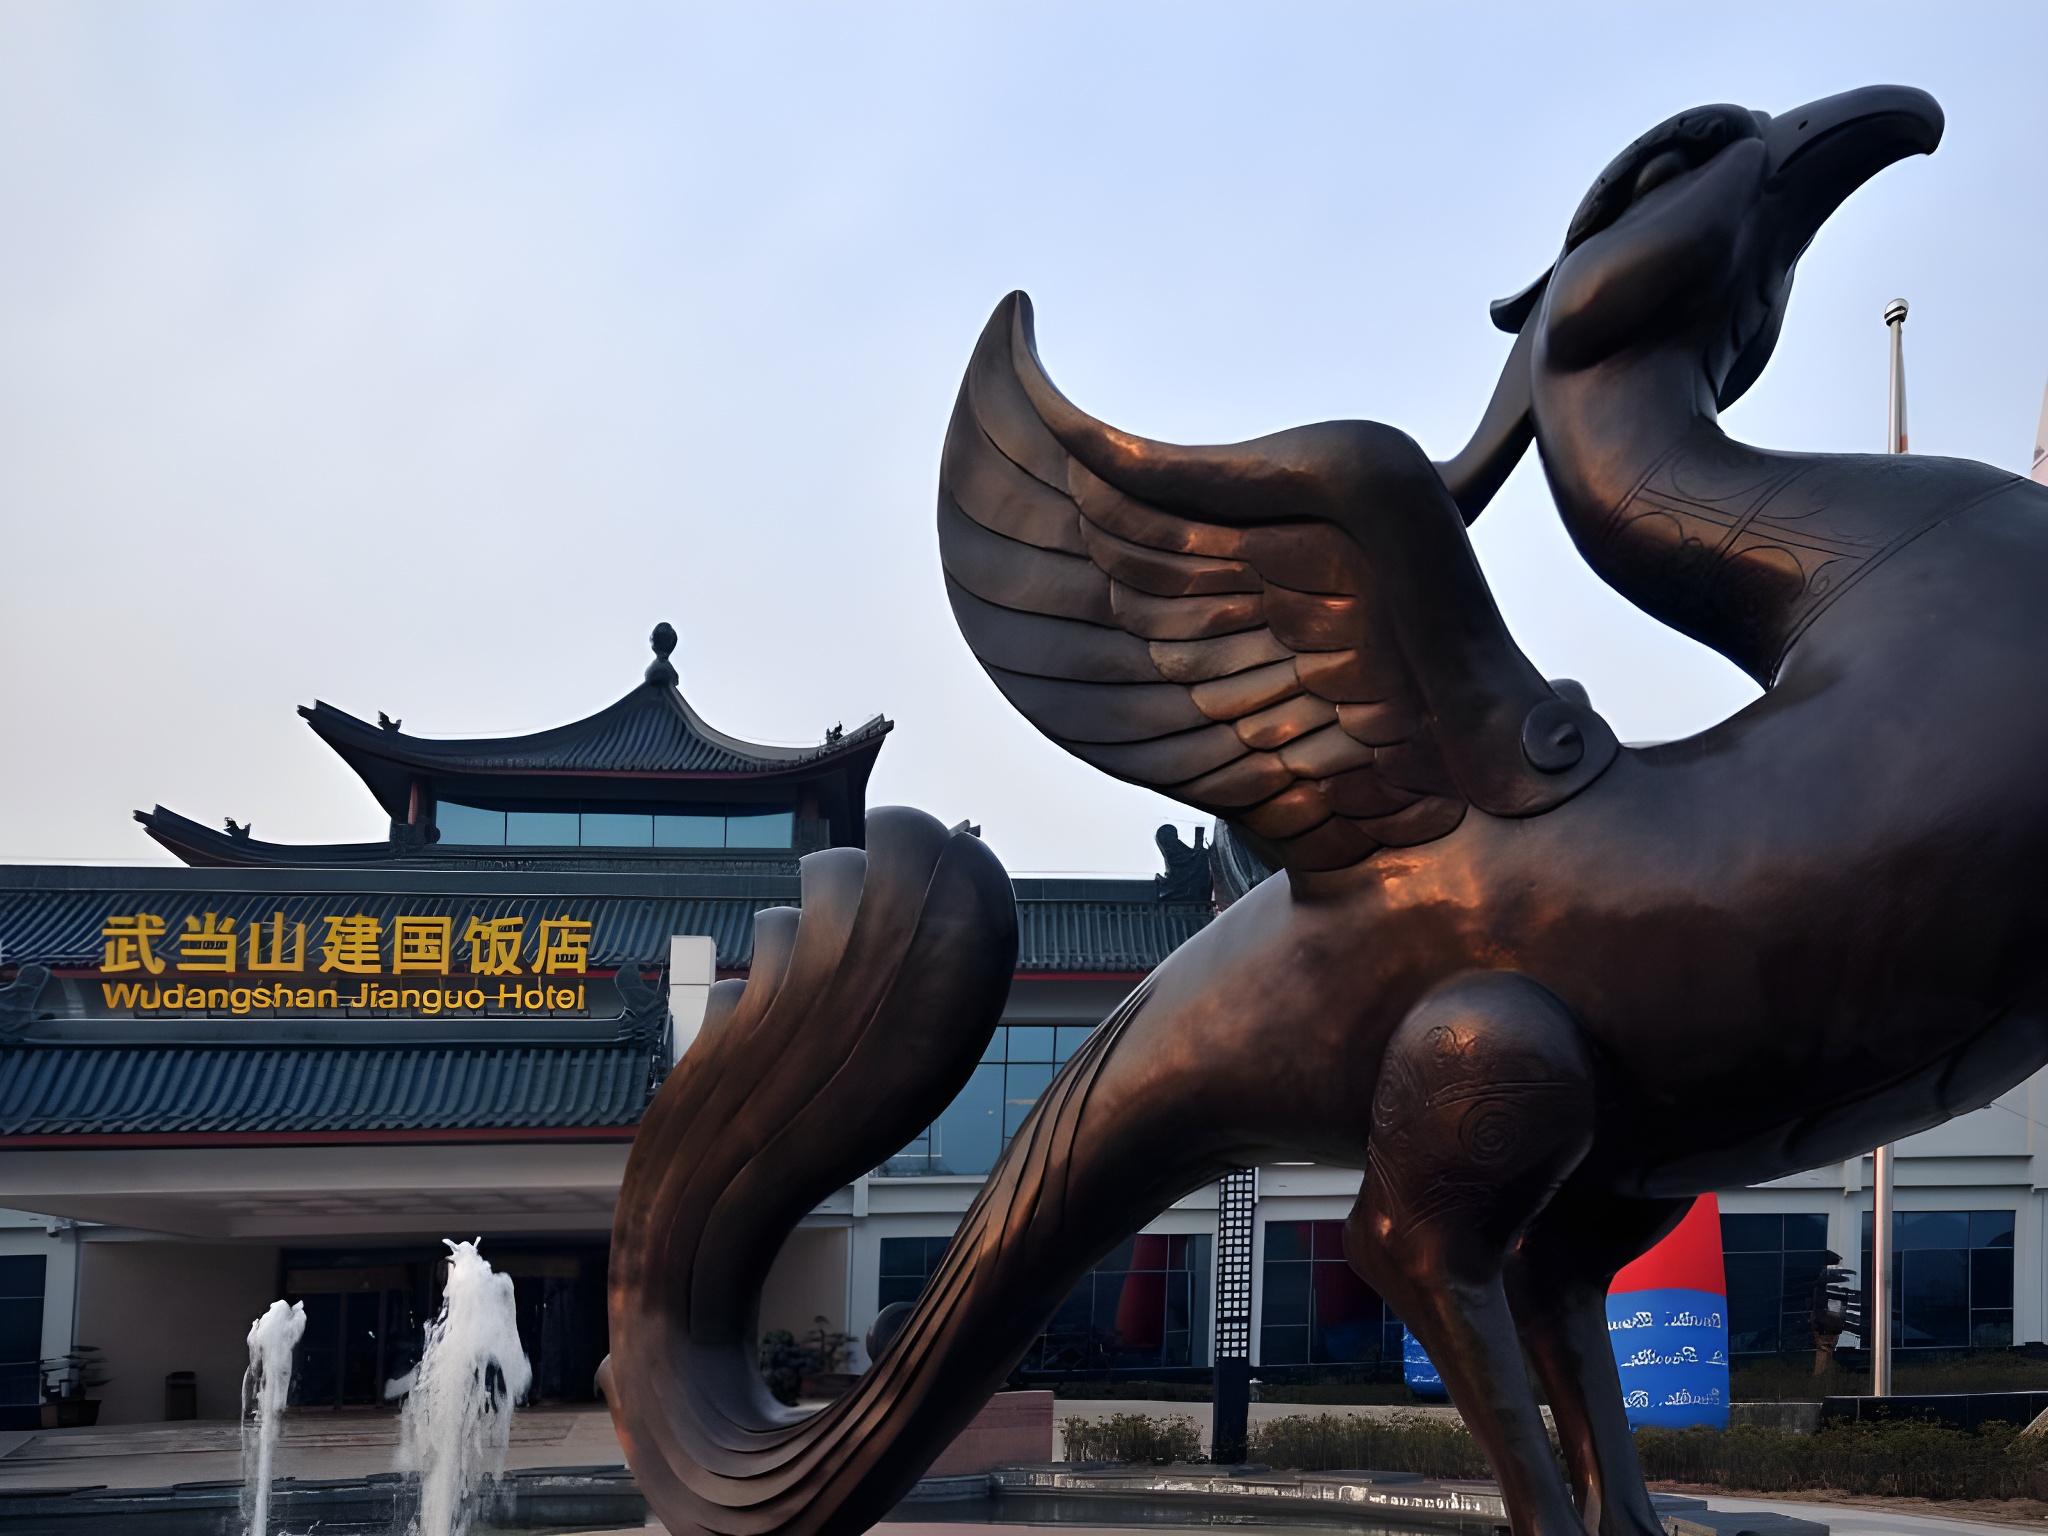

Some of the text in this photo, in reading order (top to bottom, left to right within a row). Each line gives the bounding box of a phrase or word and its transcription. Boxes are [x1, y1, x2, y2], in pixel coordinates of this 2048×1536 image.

[100, 912, 592, 975] 武当山建国饭店
[102, 983, 585, 1013] Wudangshan Jianguo Hotel
